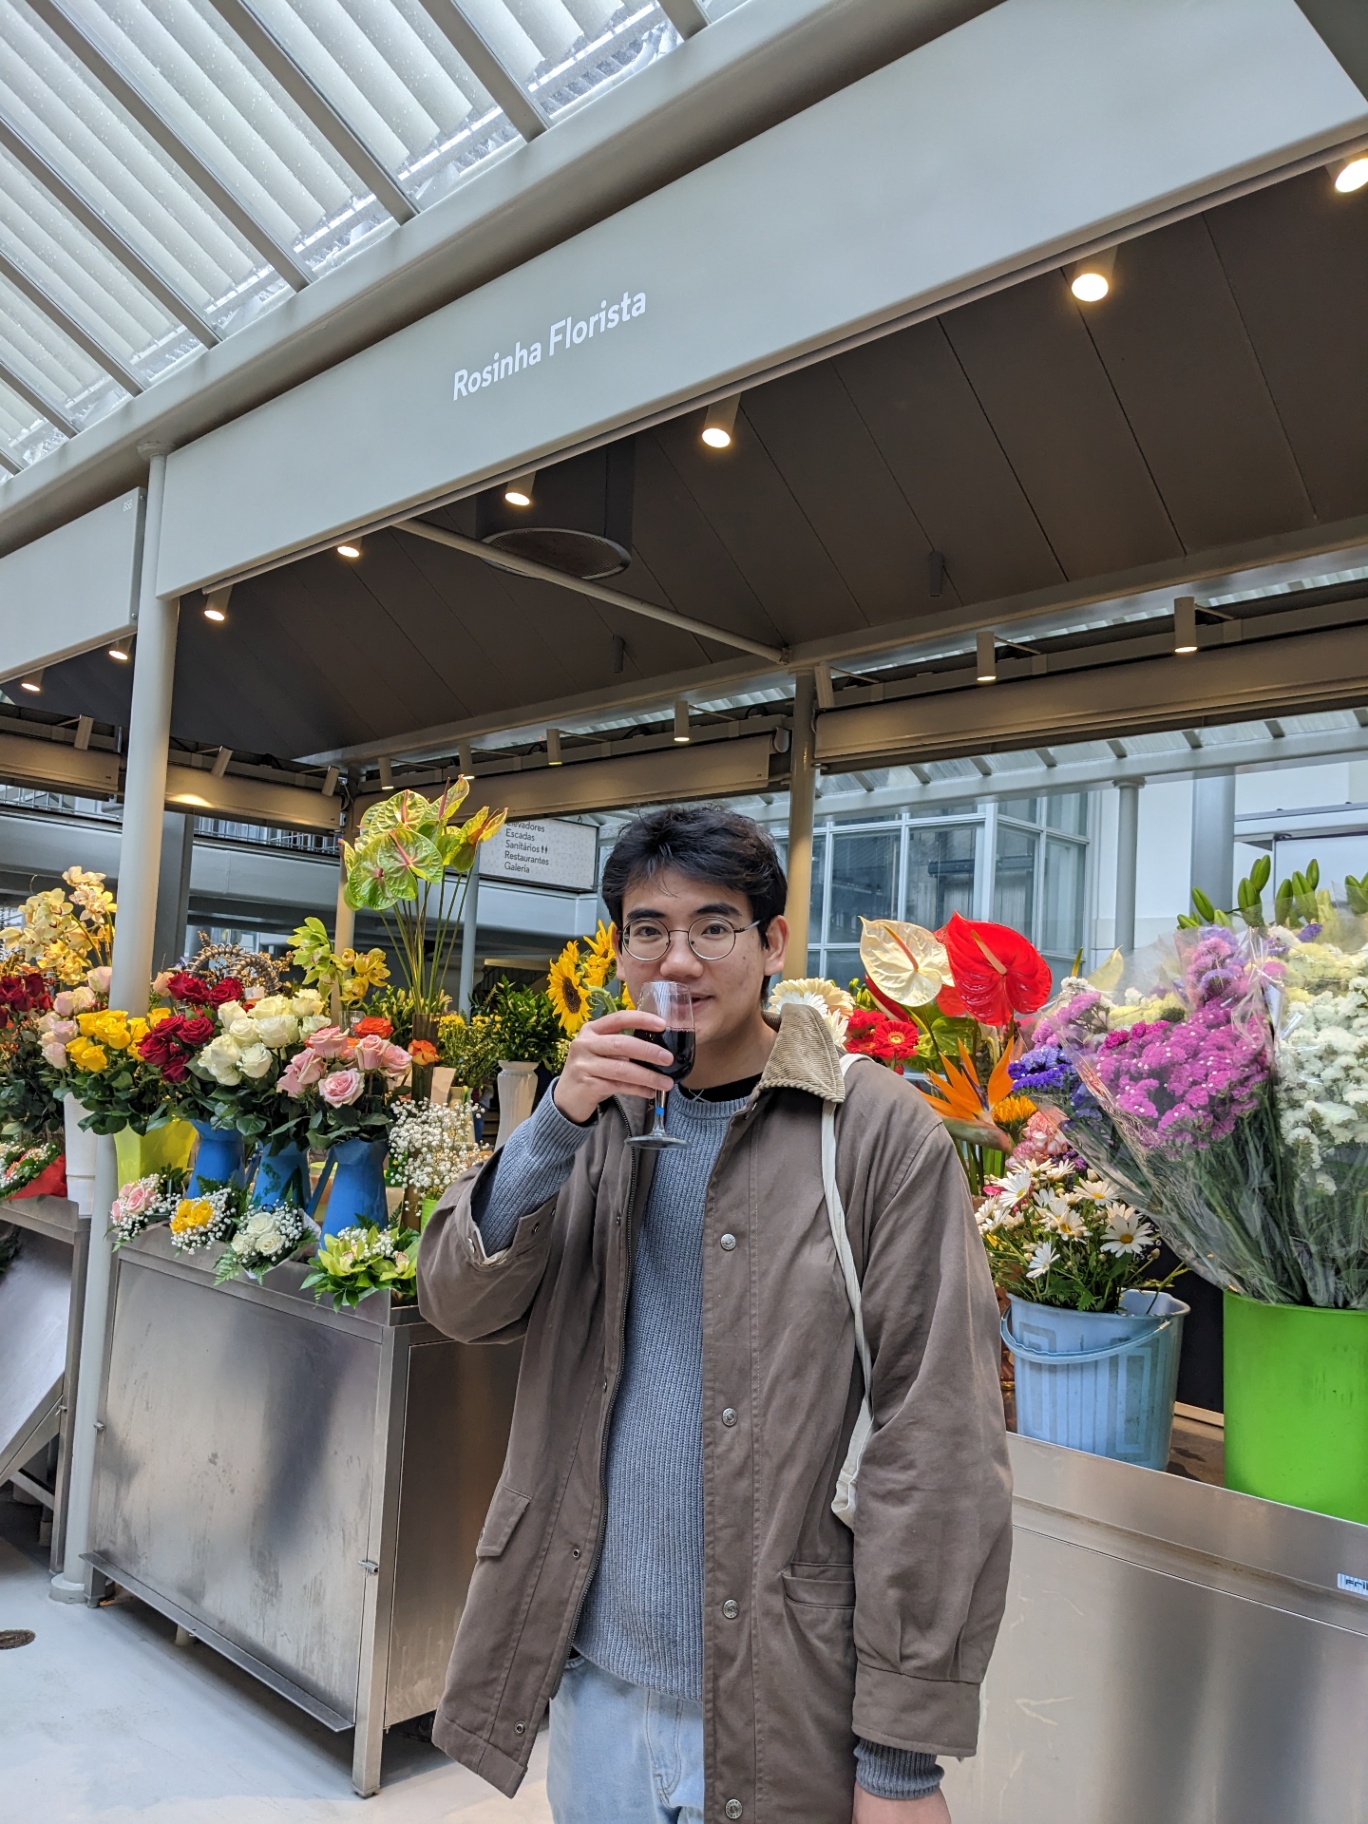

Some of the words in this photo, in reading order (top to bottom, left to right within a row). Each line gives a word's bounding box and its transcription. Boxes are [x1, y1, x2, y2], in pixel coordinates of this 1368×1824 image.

[453, 341, 542, 401] Rosinha
[549, 291, 646, 356] Florista
[505, 827, 535, 841] Escadas
[505, 839, 540, 853] Sanitários
[504, 850, 549, 866] Restaurantes
[504, 861, 530, 873] Galeria
